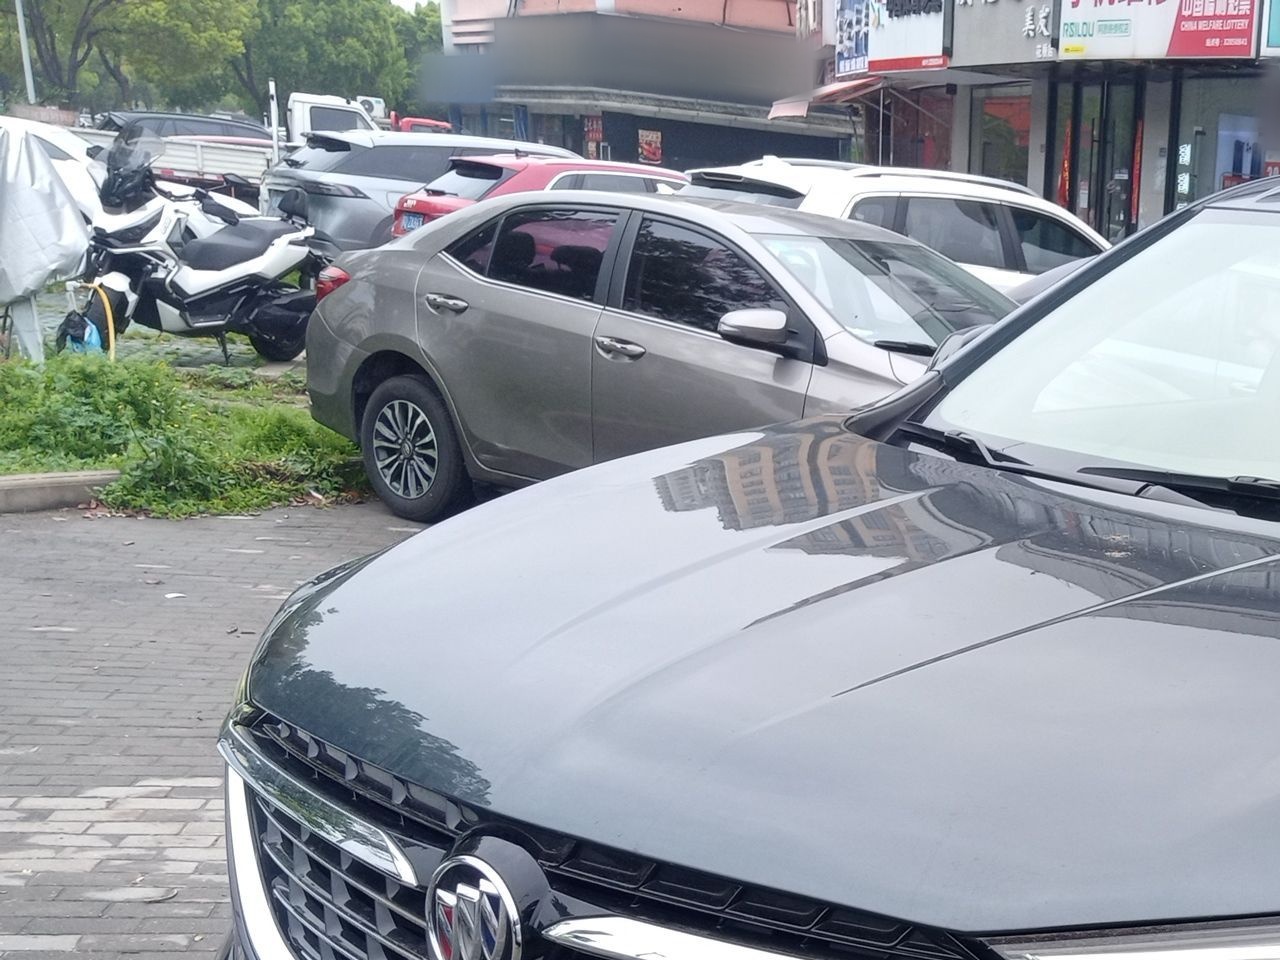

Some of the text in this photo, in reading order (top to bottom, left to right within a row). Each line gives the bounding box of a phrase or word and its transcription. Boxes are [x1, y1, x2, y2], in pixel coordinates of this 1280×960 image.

[1180, 19, 1249, 31] CHINA WELFARE LOTTERY
